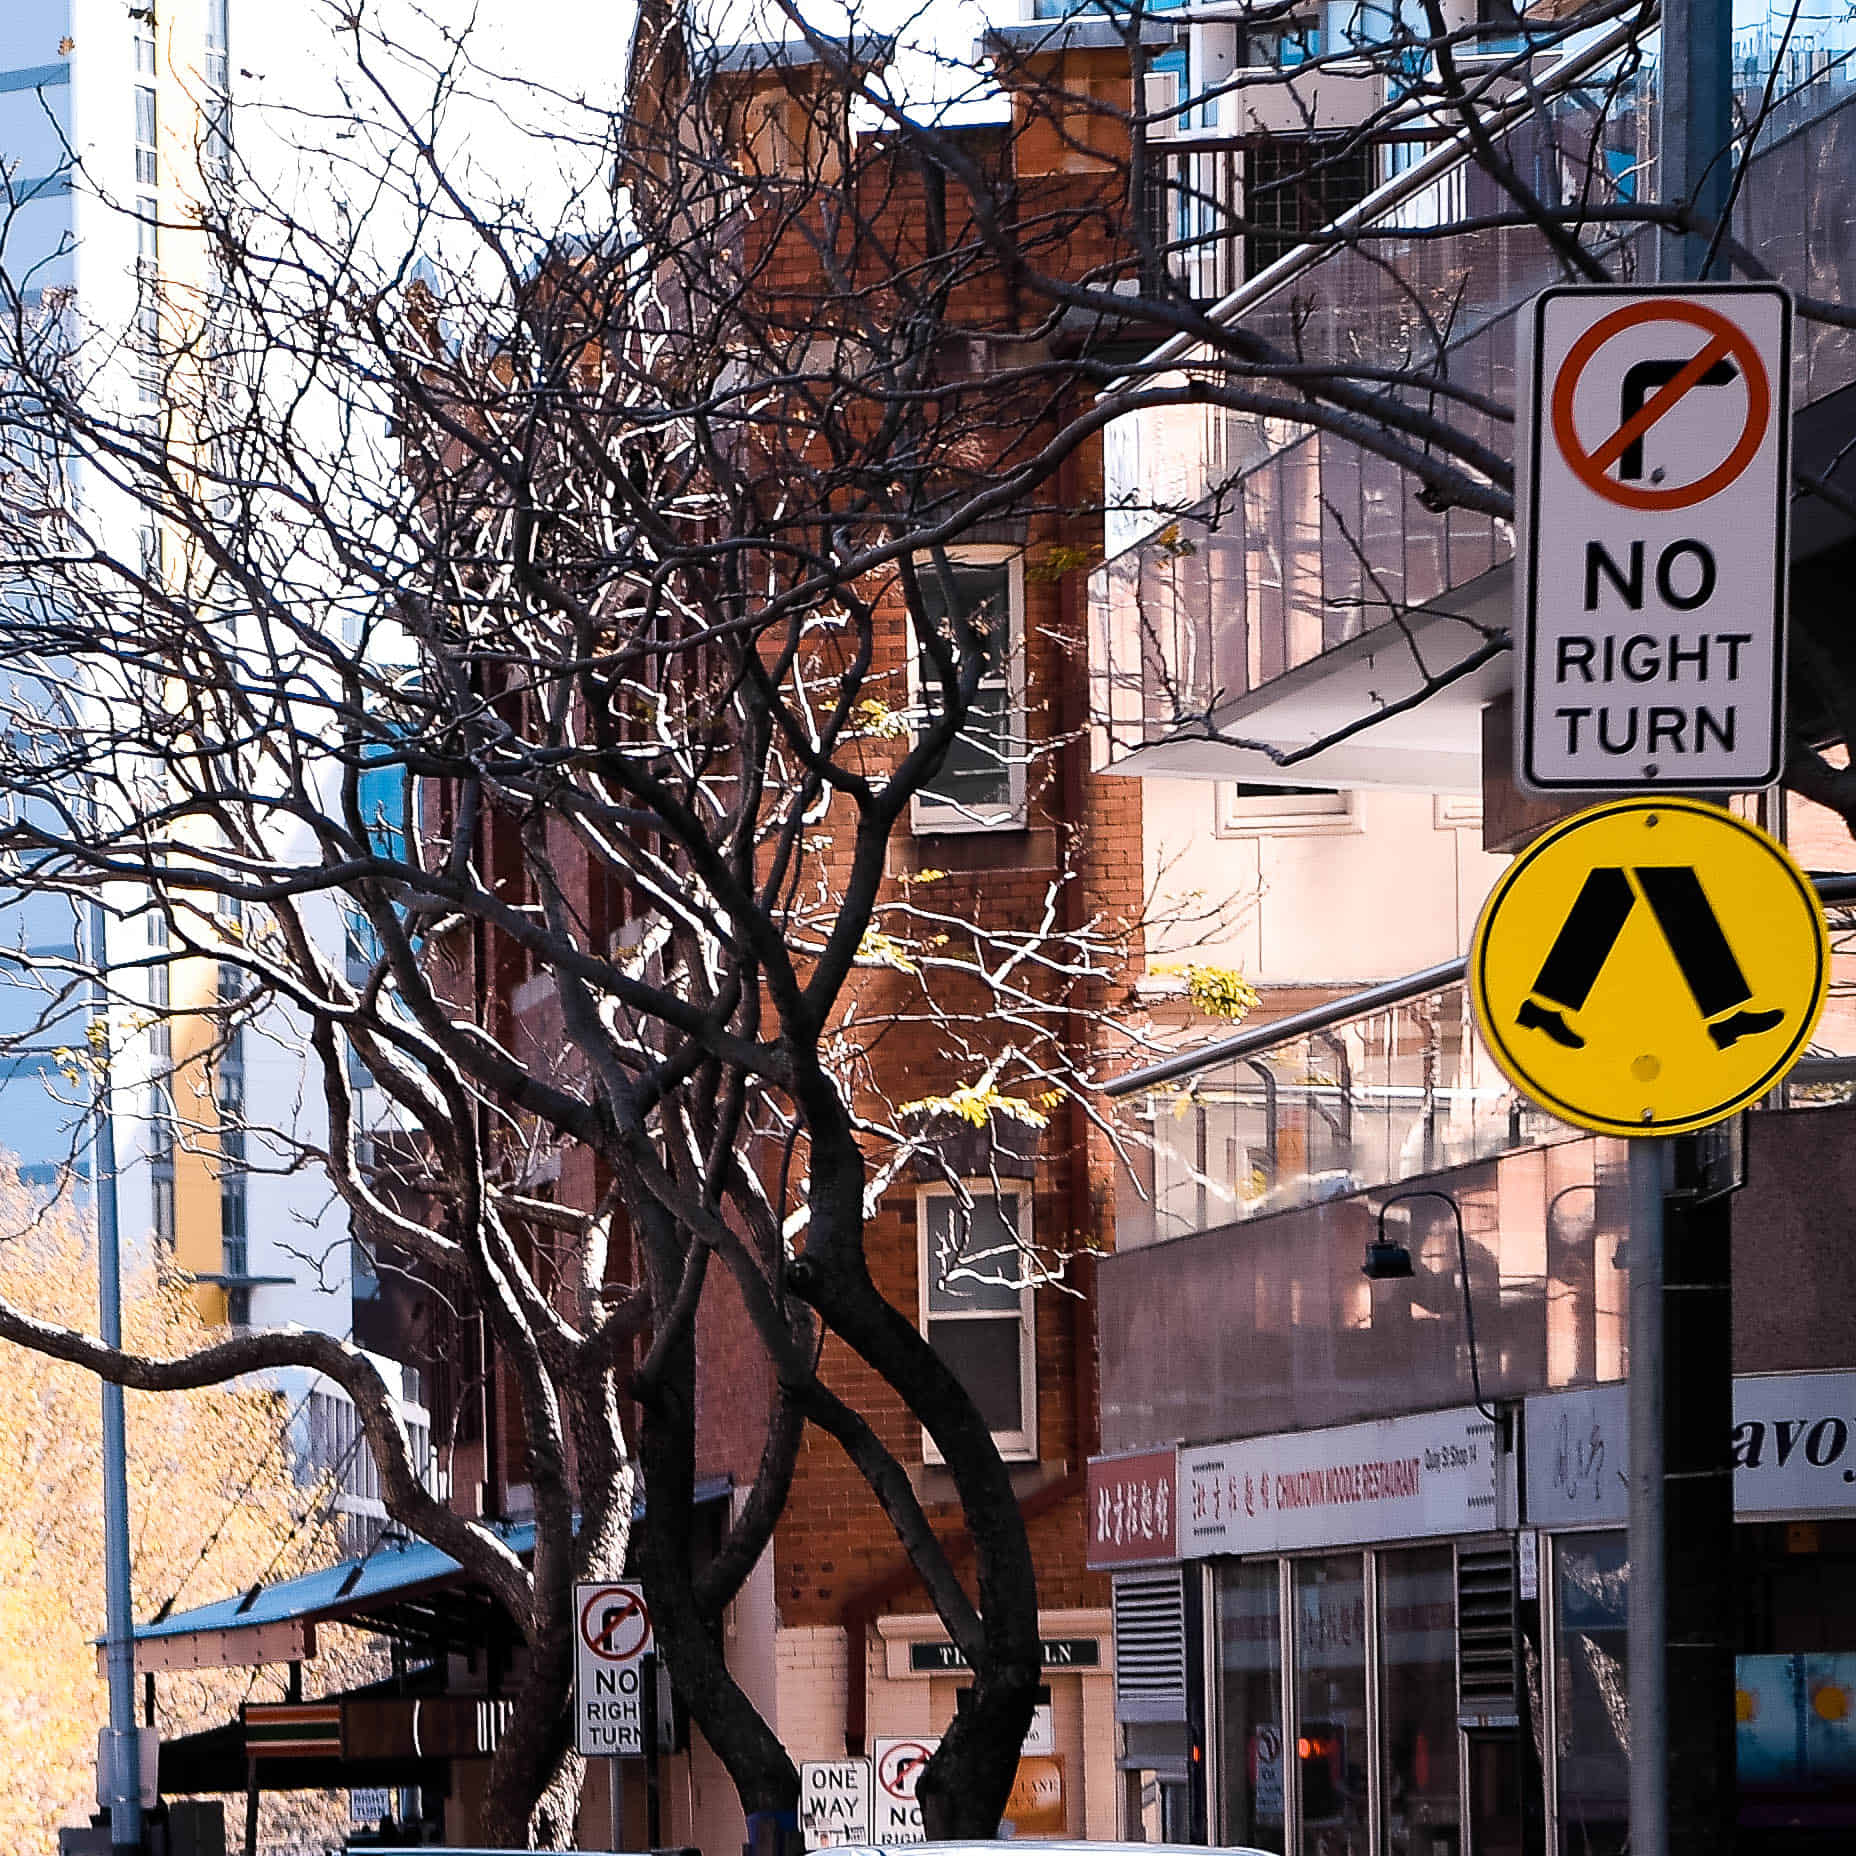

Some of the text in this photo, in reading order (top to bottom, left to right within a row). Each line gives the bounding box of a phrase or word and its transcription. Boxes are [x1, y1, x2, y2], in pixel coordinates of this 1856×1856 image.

[1583, 537, 1717, 612] NO
[1556, 632, 1753, 684] RIGHT
[1555, 705, 1738, 756] TURN
[1732, 1416, 1856, 1484] avo
[595, 1668, 639, 1696] NO
[588, 1702, 641, 1722] RIGH
[812, 1769, 858, 1789] ONE
[809, 1796, 859, 1819] WAY
[889, 1807, 924, 1827] NO
